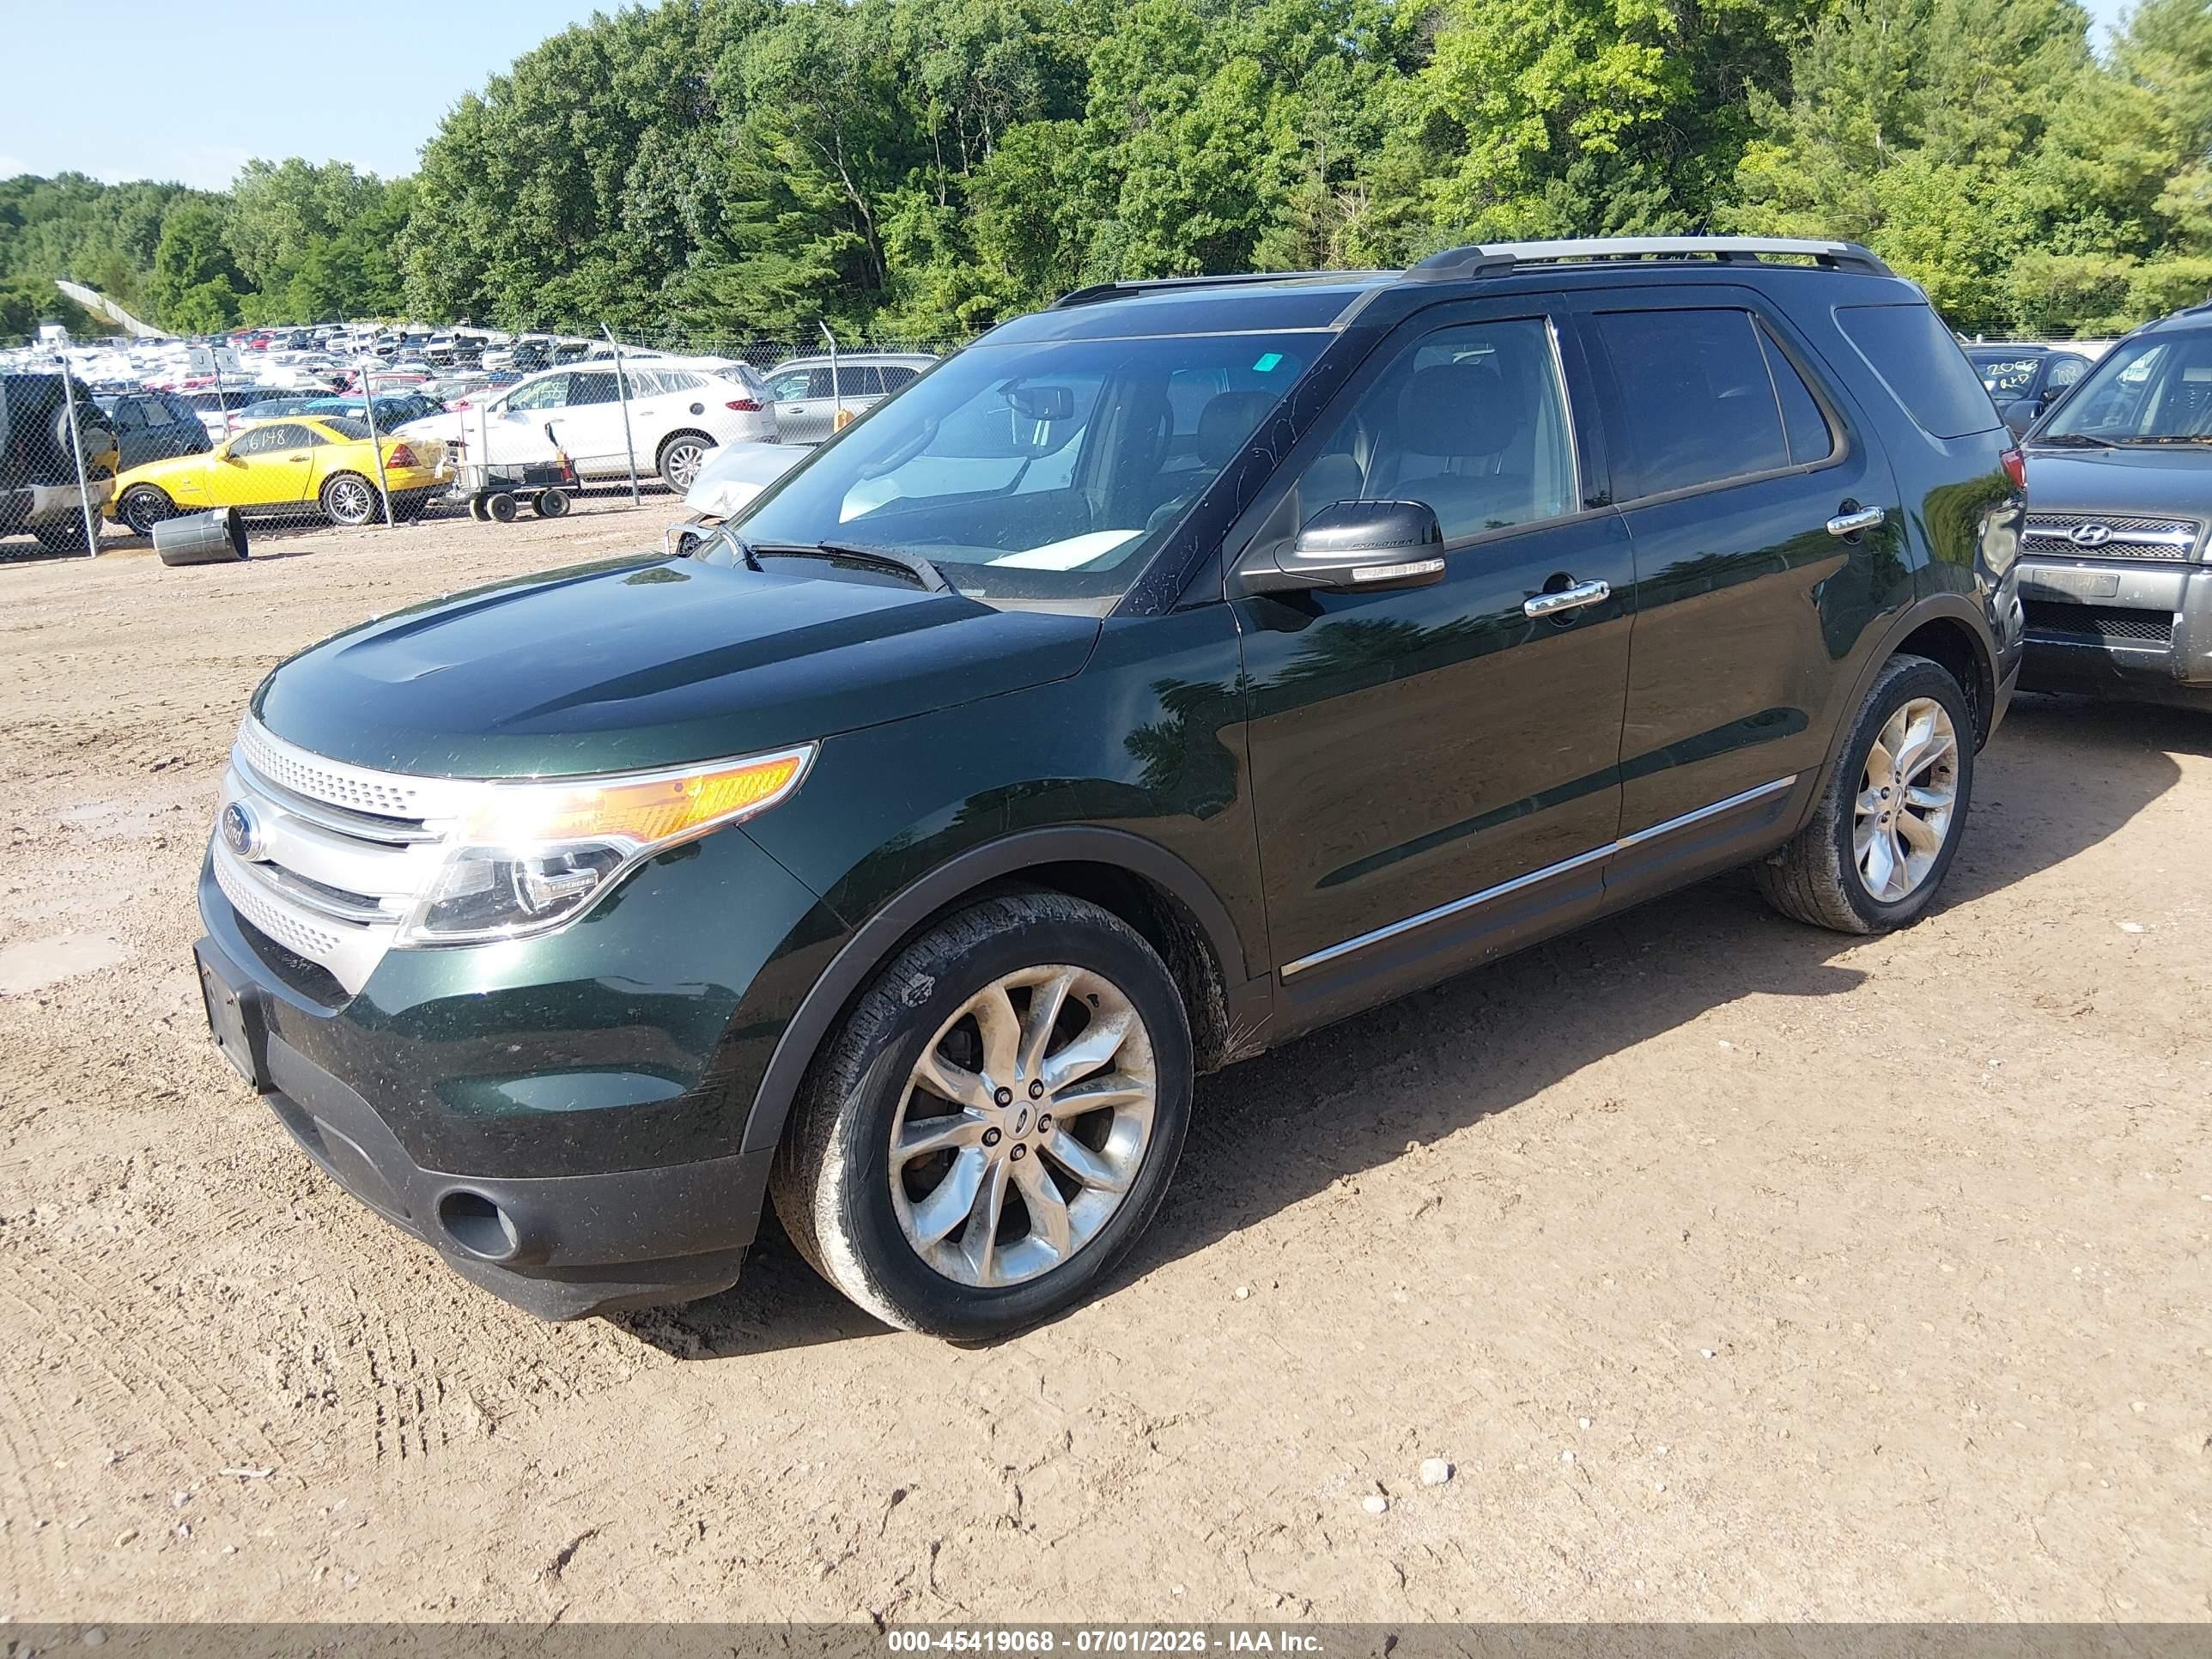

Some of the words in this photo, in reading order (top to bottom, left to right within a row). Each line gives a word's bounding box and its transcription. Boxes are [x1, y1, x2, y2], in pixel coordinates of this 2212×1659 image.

[198, 356, 204, 365] J
[226, 355, 234, 365] K
[250, 428, 286, 450] 6148
[225, 809, 244, 846] Ford
